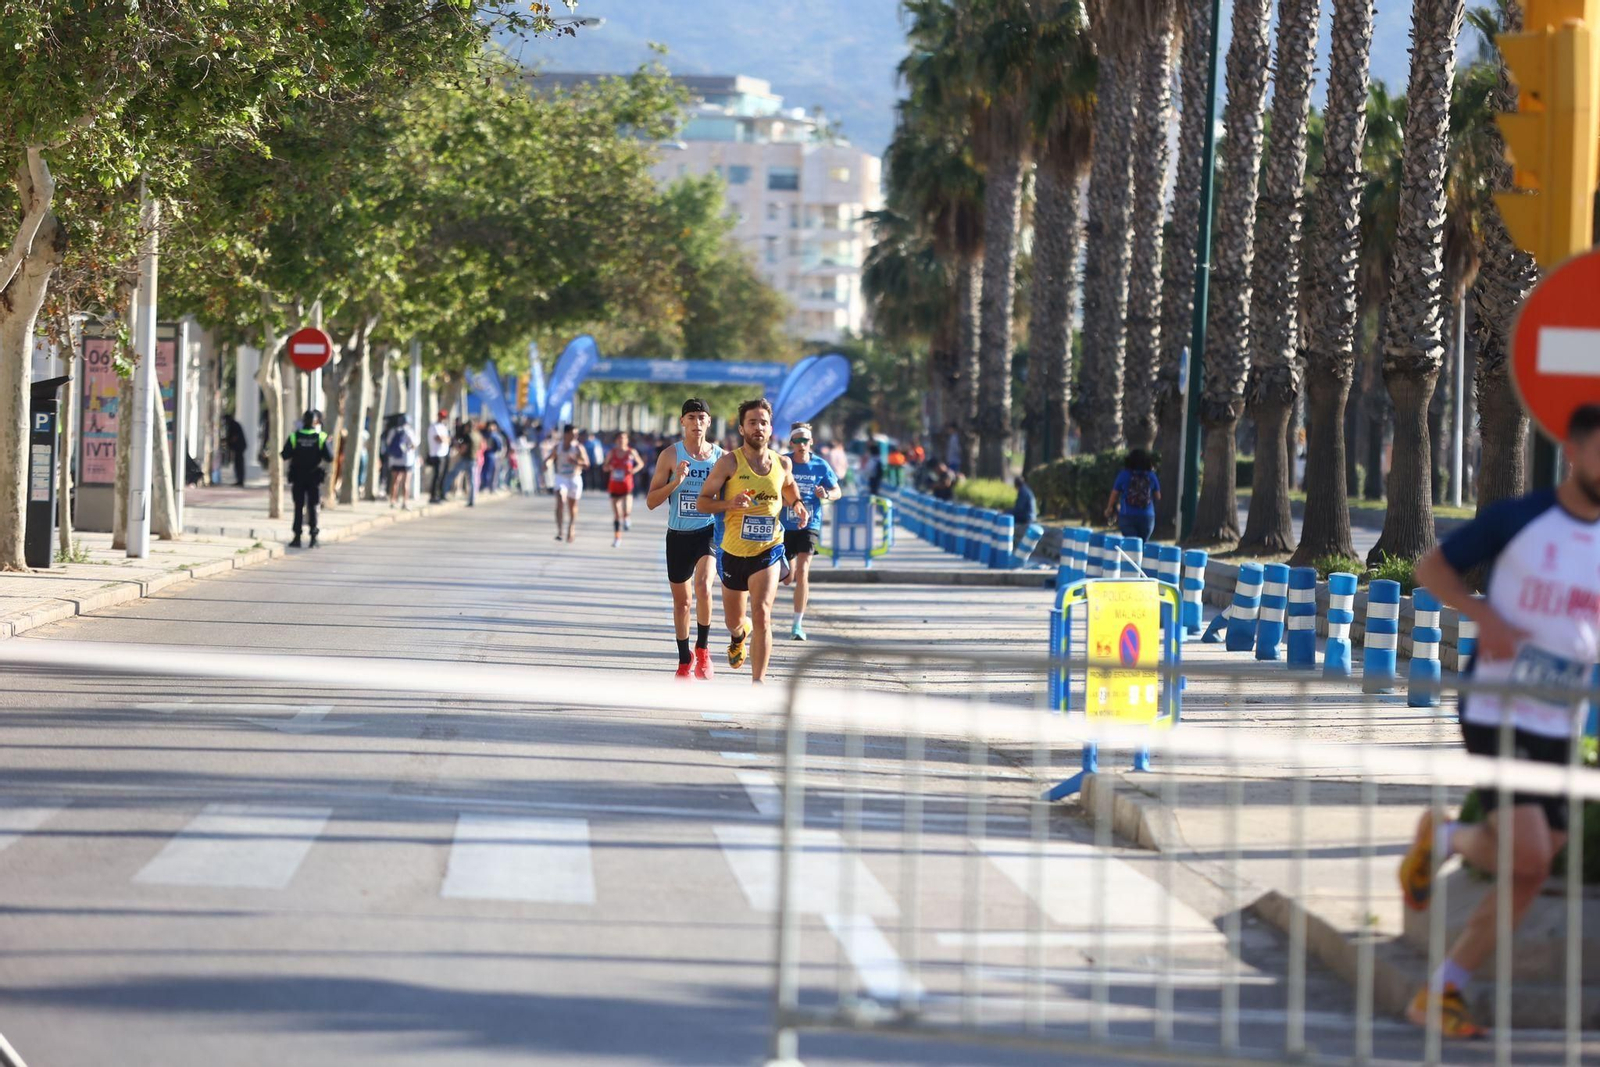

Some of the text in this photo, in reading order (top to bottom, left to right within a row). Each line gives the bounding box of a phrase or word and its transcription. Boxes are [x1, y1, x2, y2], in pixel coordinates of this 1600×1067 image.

[89, 350, 110, 365] 06
[35, 413, 49, 429] P
[687, 467, 710, 481] erj
[683, 502, 696, 510] 16
[746, 525, 772, 534] 1596
